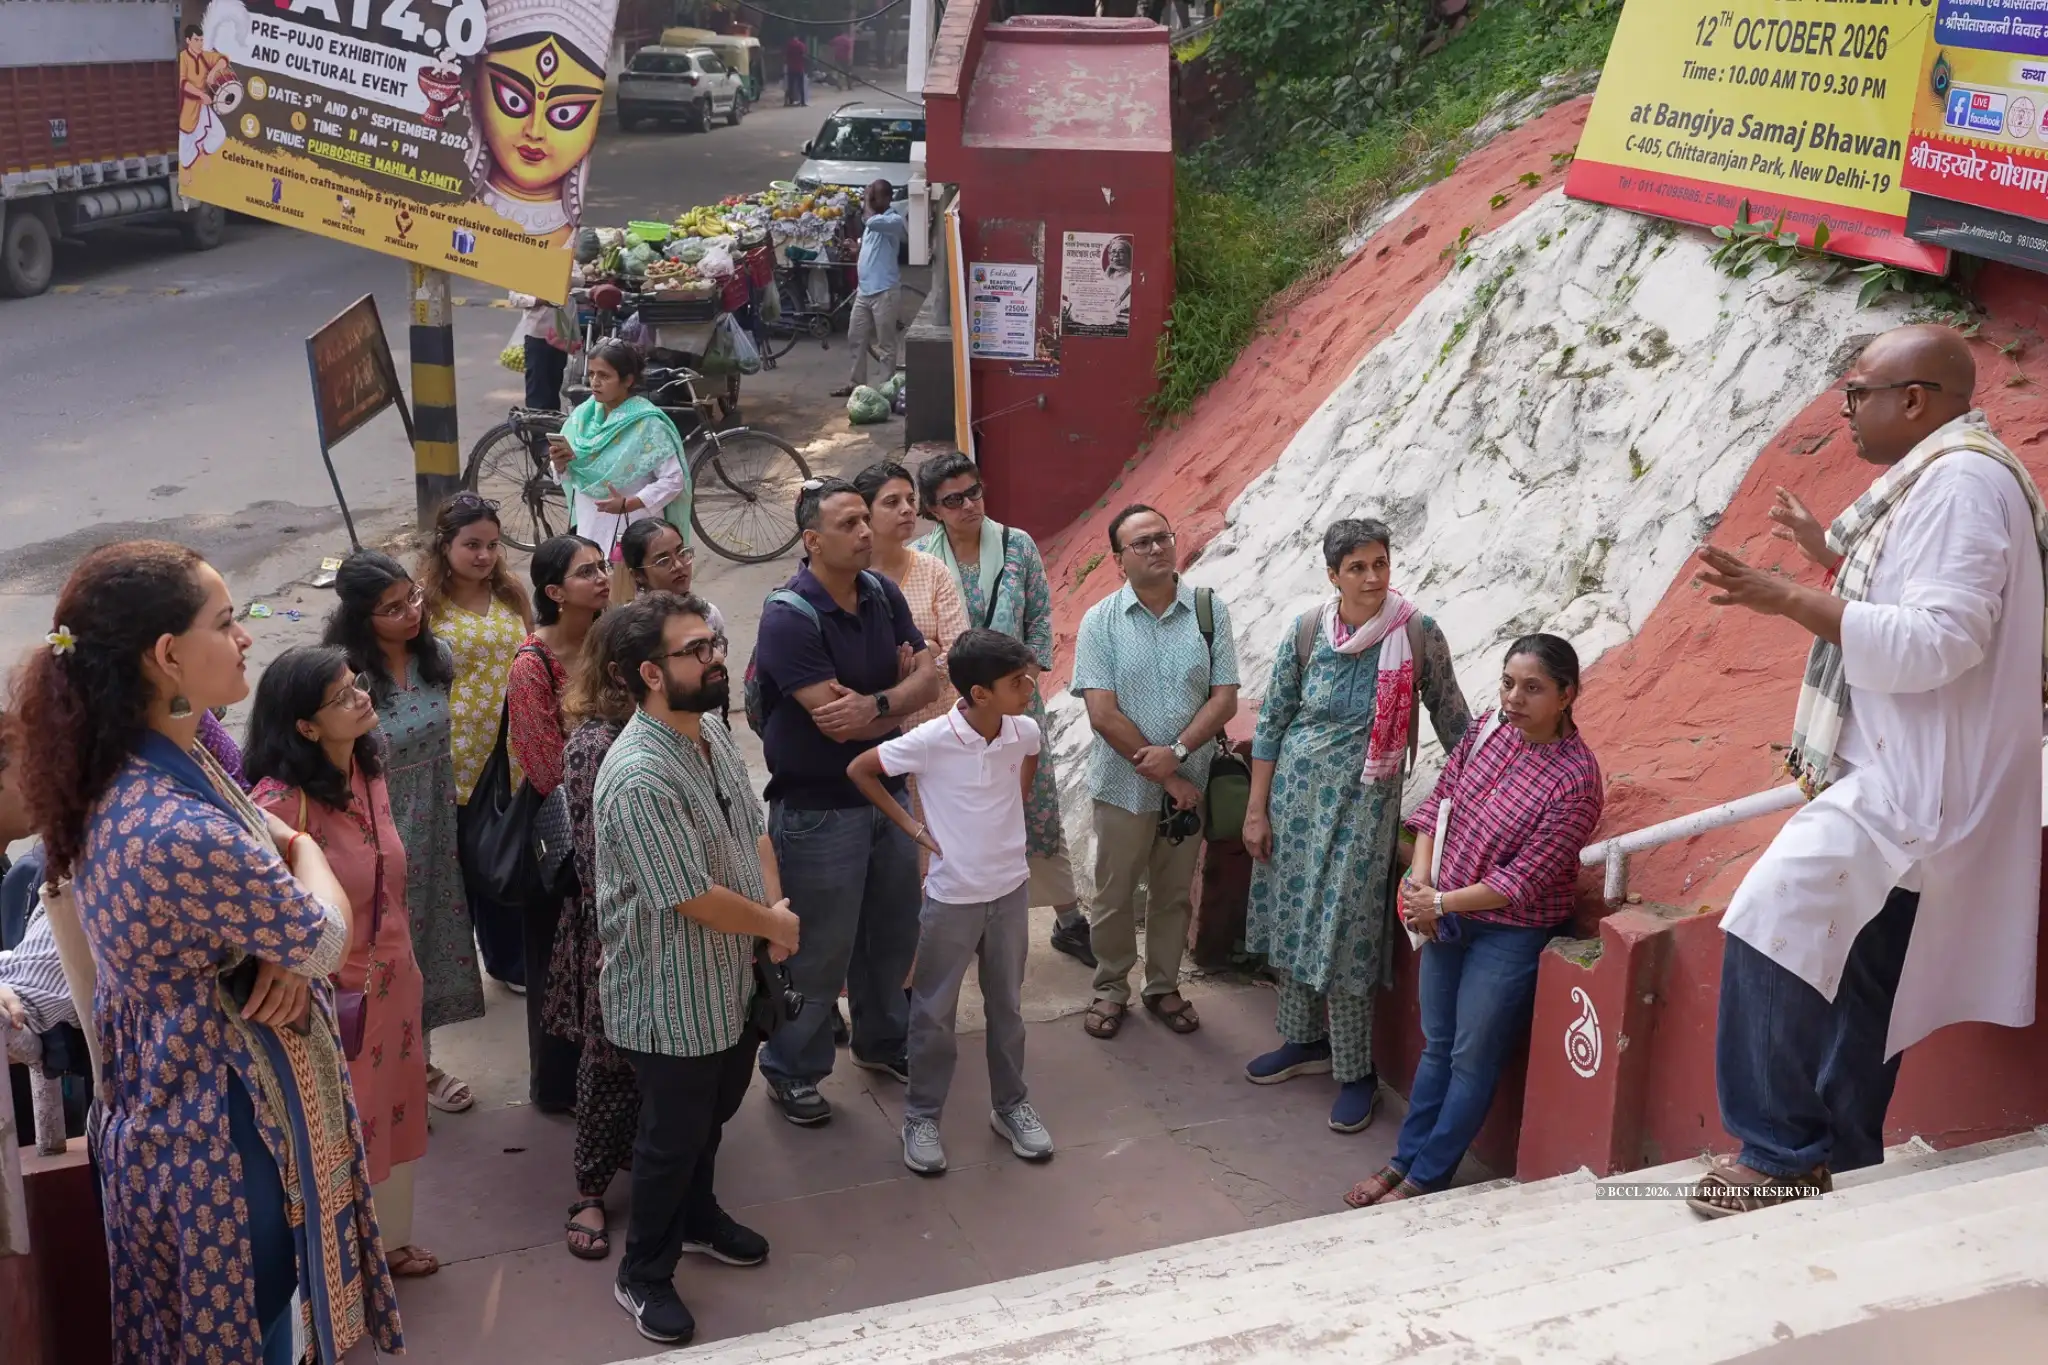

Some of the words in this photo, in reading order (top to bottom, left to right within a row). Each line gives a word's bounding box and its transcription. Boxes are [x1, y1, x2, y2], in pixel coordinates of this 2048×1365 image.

[251, 20, 323, 51] PRE-PUJO
[329, 40, 407, 73] EXHIBITION
[1733, 18, 1836, 56] OCTOBER
[1839, 24, 1890, 61] 2026
[2011, 17, 2042, 38] विवाह
[251, 45, 280, 64] AND
[286, 53, 357, 85] CULTURAL
[362, 73, 409, 98] EVENT
[1682, 60, 1716, 82] Time
[1729, 65, 1769, 87] 10.00
[1770, 69, 1796, 90] AM
[1800, 71, 1821, 92] TO
[1823, 75, 1859, 96] 9.30
[1861, 77, 1887, 100] PM
[2021, 67, 2046, 82] कथा
[268, 87, 302, 106] DATE:
[324, 101, 348, 119] AND
[370, 113, 437, 142] SEPTEMBER
[441, 131, 469, 150] 2026
[1970, 113, 2000, 127] facebook
[1972, 96, 1989, 108] LIVE
[312, 118, 342, 138] TIME:
[348, 128, 358, 142] 11
[359, 134, 378, 148] AM
[391, 140, 399, 154] 9
[401, 143, 420, 159] PM
[1629, 103, 1652, 124] at
[1653, 103, 1735, 138] Bangiya
[1737, 114, 1808, 153] Samaj
[1809, 123, 1902, 161] Bhawan
[266, 127, 305, 150] VENUE:
[308, 139, 372, 168] PURBOSREE
[375, 157, 417, 181] MAHILA
[419, 170, 463, 193] SAMITY
[1625, 135, 1663, 159] C-405,
[1666, 140, 1748, 171] Chittaranjan
[1750, 153, 1786, 178] Park,
[1789, 162, 1823, 183] New
[1824, 165, 1891, 194] Delhi-19
[1910, 141, 1988, 181] श्रीजड़खोर
[222, 150, 264, 171] Celebrate
[265, 160, 309, 184] tradition,
[309, 176, 374, 201] craftsmanship
[375, 193, 382, 203] &
[384, 195, 407, 212] style
[409, 203, 429, 218] with
[431, 211, 446, 221] our
[447, 214, 490, 233] exclusive
[492, 225, 536, 246] collection
[538, 239, 550, 250] of
[246, 195, 281, 213] HANDLOOM
[281, 206, 304, 219] SAREES
[1618, 176, 1632, 189] Tel
[1704, 193, 1737, 209] E-Mail
[322, 218, 341, 230] HOME
[342, 223, 365, 236] DECORE
[384, 236, 419, 251] JEWELLERY
[1998, 231, 2013, 244] Das
[444, 252, 459, 262] AND
[459, 257, 479, 269] MORE
